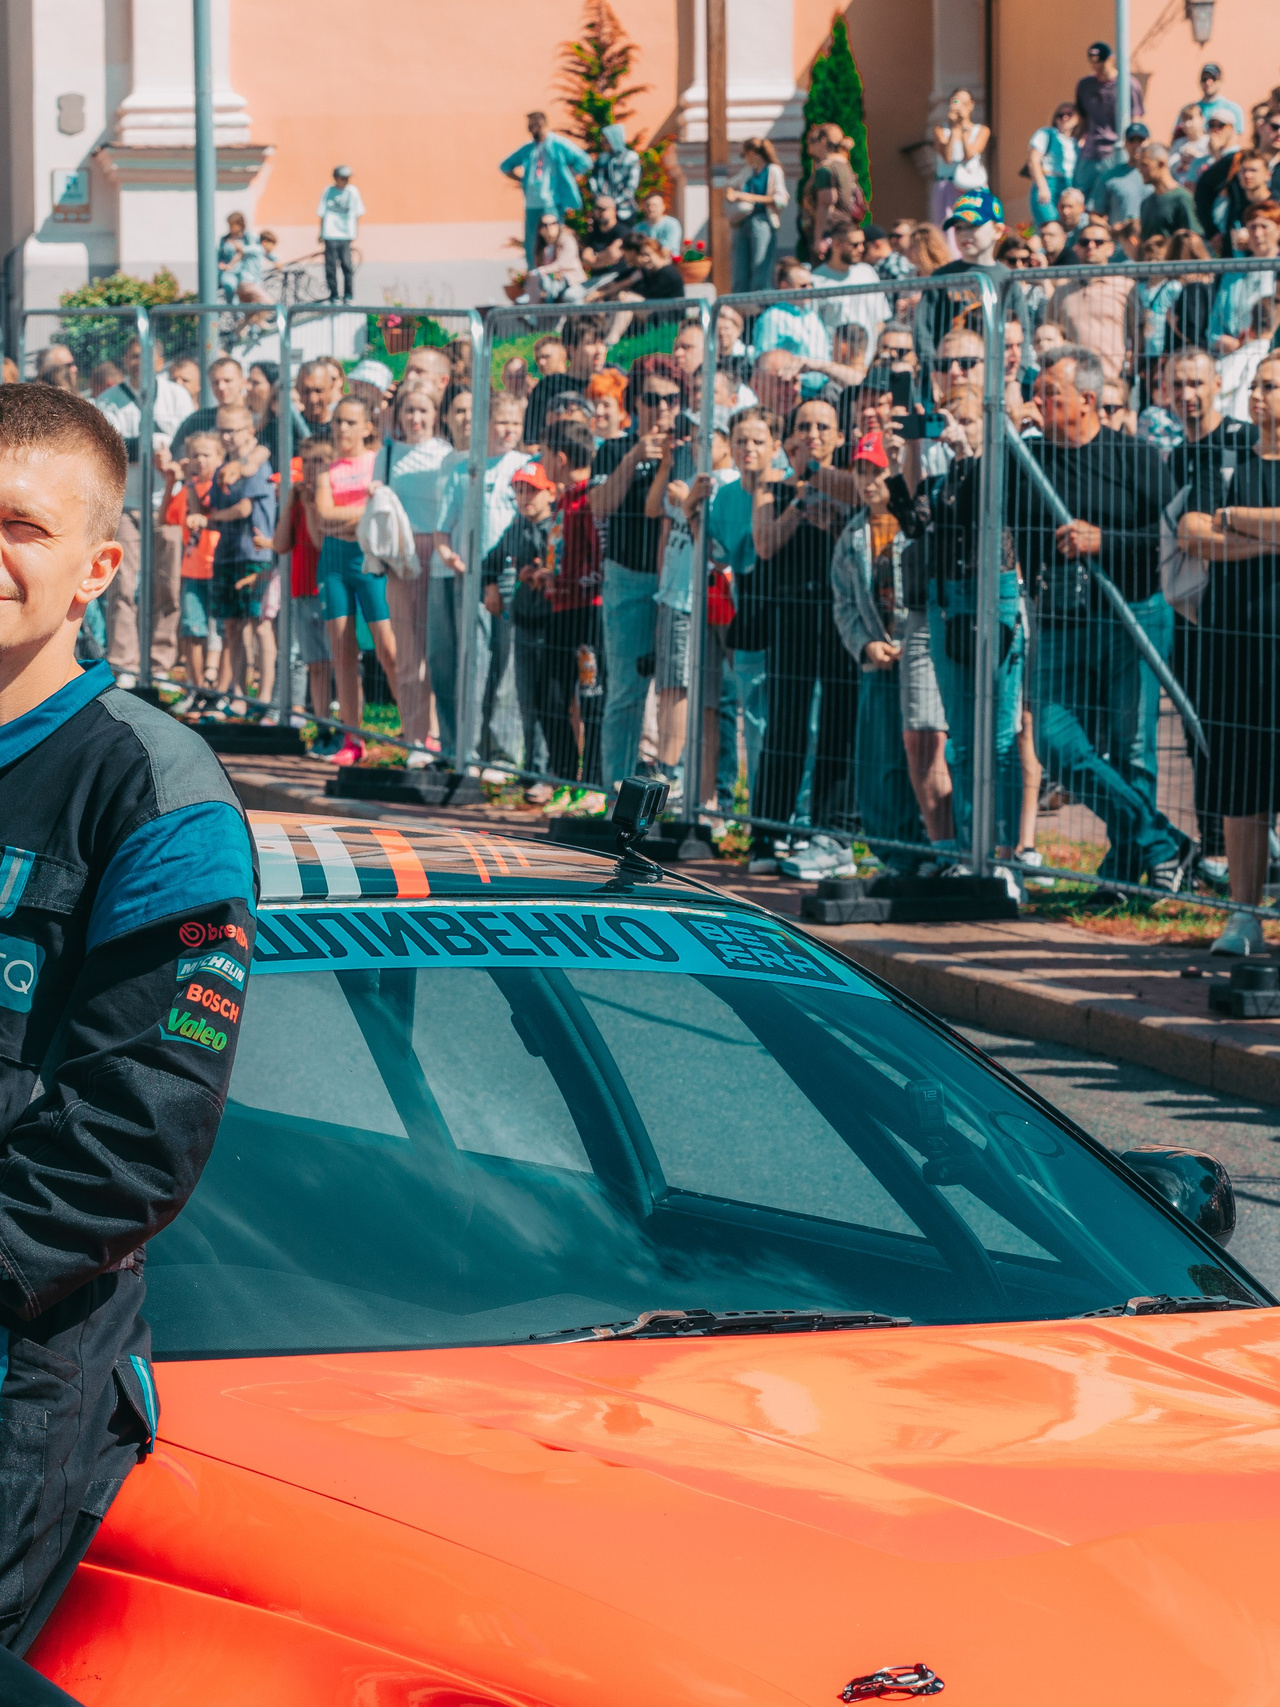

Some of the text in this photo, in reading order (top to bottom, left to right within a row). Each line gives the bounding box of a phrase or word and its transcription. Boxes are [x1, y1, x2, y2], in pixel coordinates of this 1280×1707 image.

[252, 910, 680, 963] ШЛИВЕНКО
[180, 955, 245, 983] MICHELIN
[186, 983, 240, 1024] BOSCH
[167, 1008, 227, 1051] Valeo
